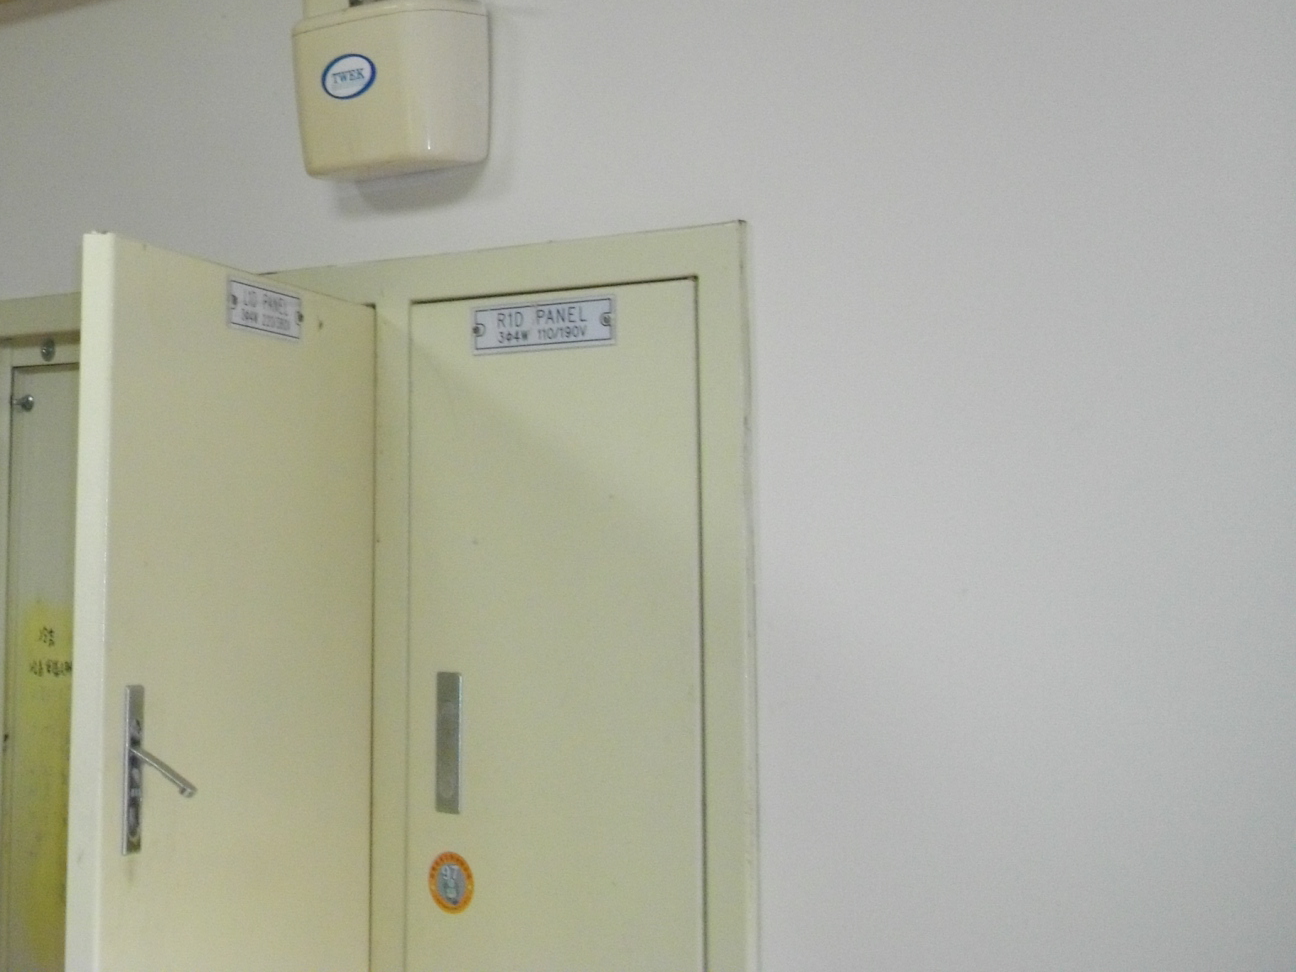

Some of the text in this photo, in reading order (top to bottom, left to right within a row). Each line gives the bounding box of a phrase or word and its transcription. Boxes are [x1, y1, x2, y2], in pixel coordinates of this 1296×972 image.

[263, 292, 288, 317] PANEL
[536, 306, 587, 326] PANEL
[537, 325, 587, 341] 110/190V
